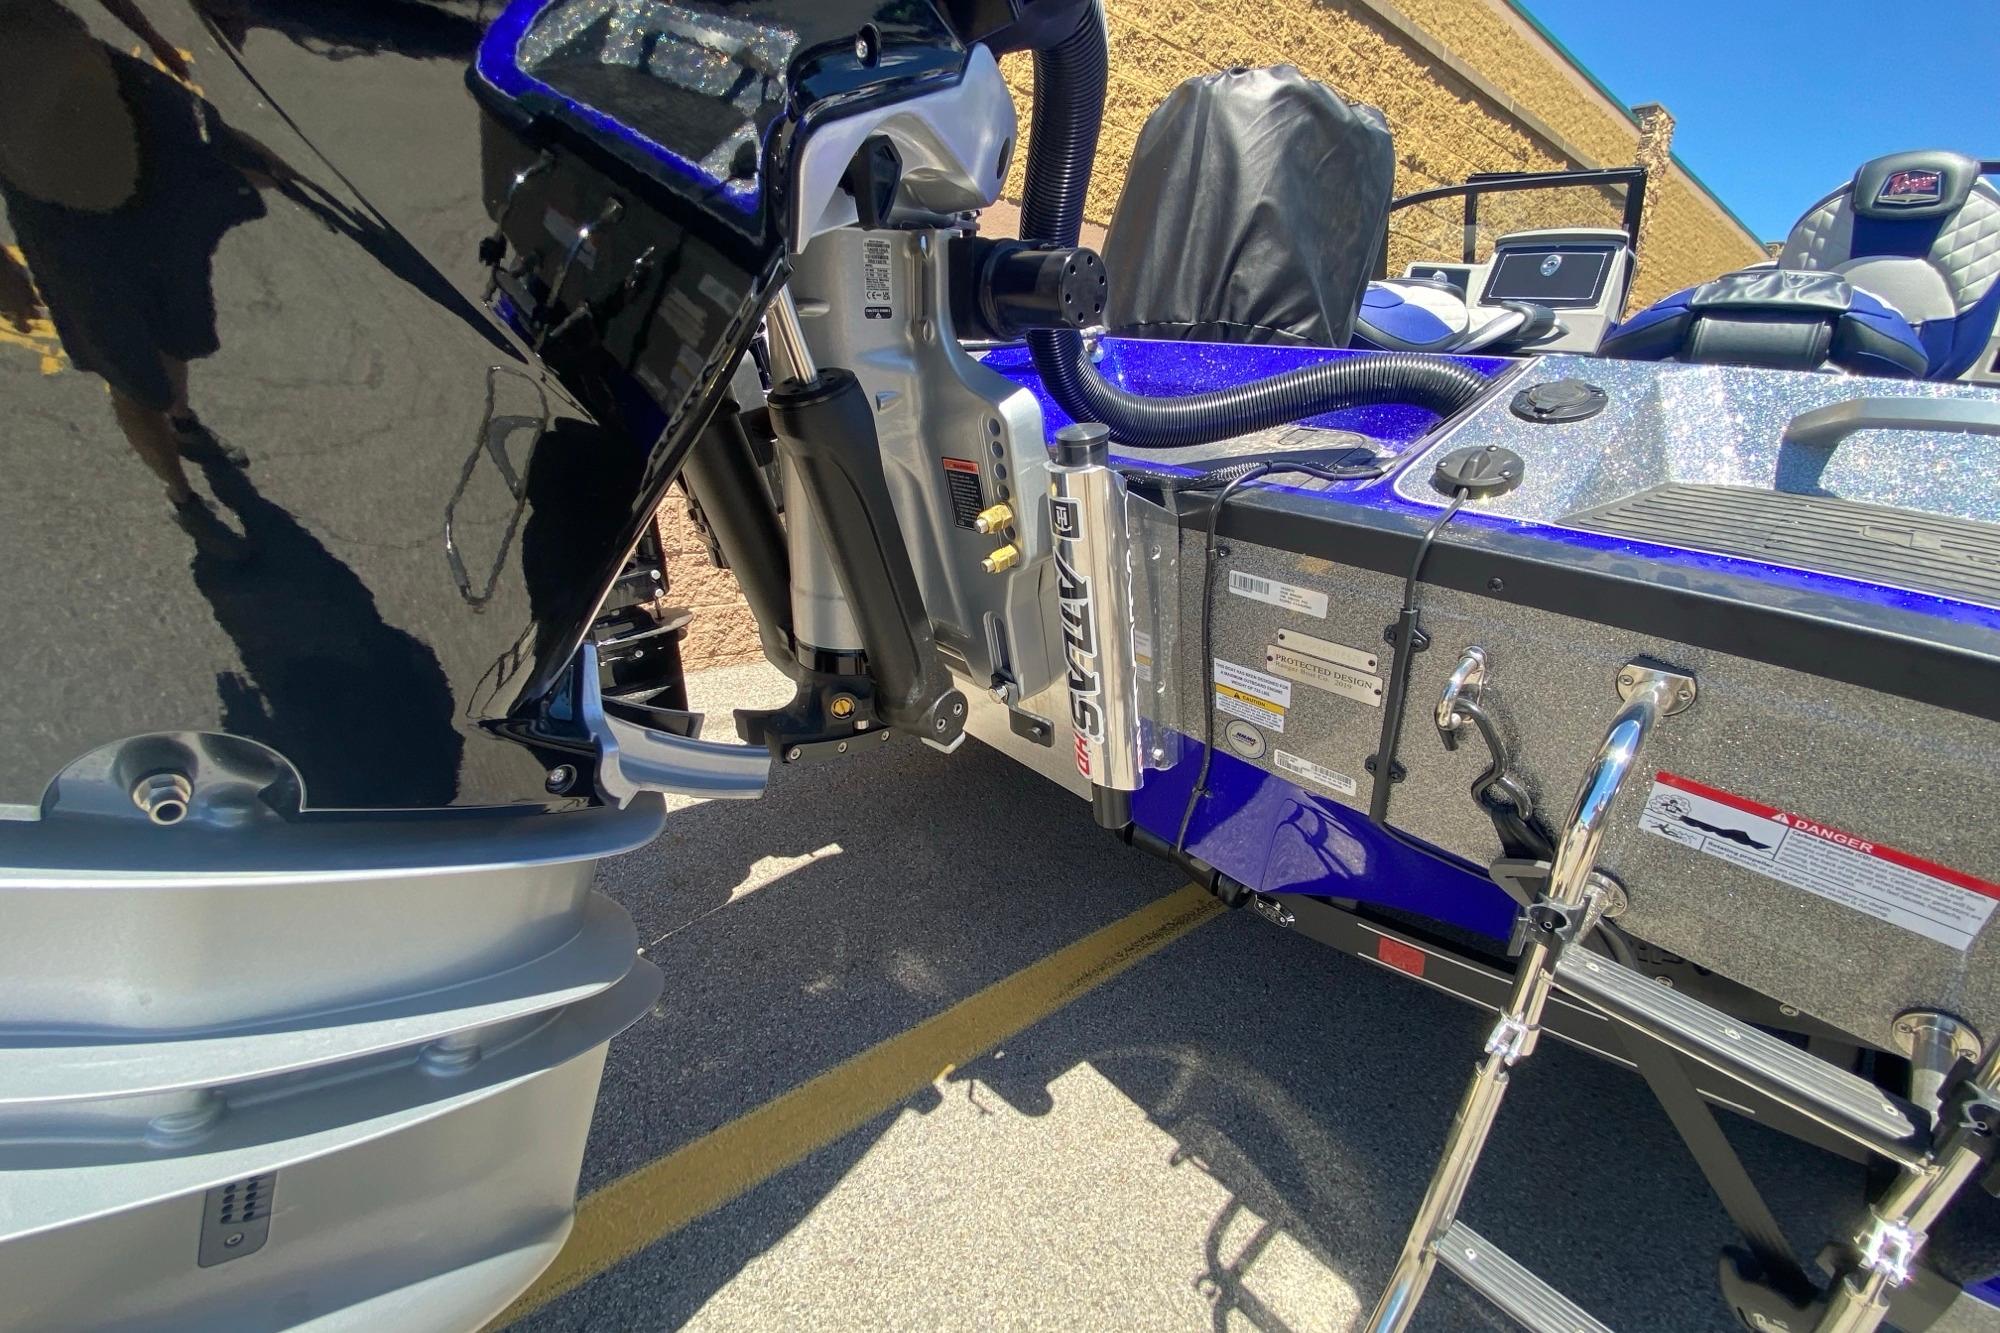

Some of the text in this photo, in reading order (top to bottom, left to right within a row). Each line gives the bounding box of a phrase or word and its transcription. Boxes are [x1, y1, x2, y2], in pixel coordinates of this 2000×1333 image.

[1053, 547, 1103, 778] ATLAS HD
[1275, 653, 1373, 690] PROTECTED DESIGN
[1242, 695, 1266, 707] CAUTION
[1334, 679, 1352, 690] 2019
[1794, 820, 1874, 853] DANGER
